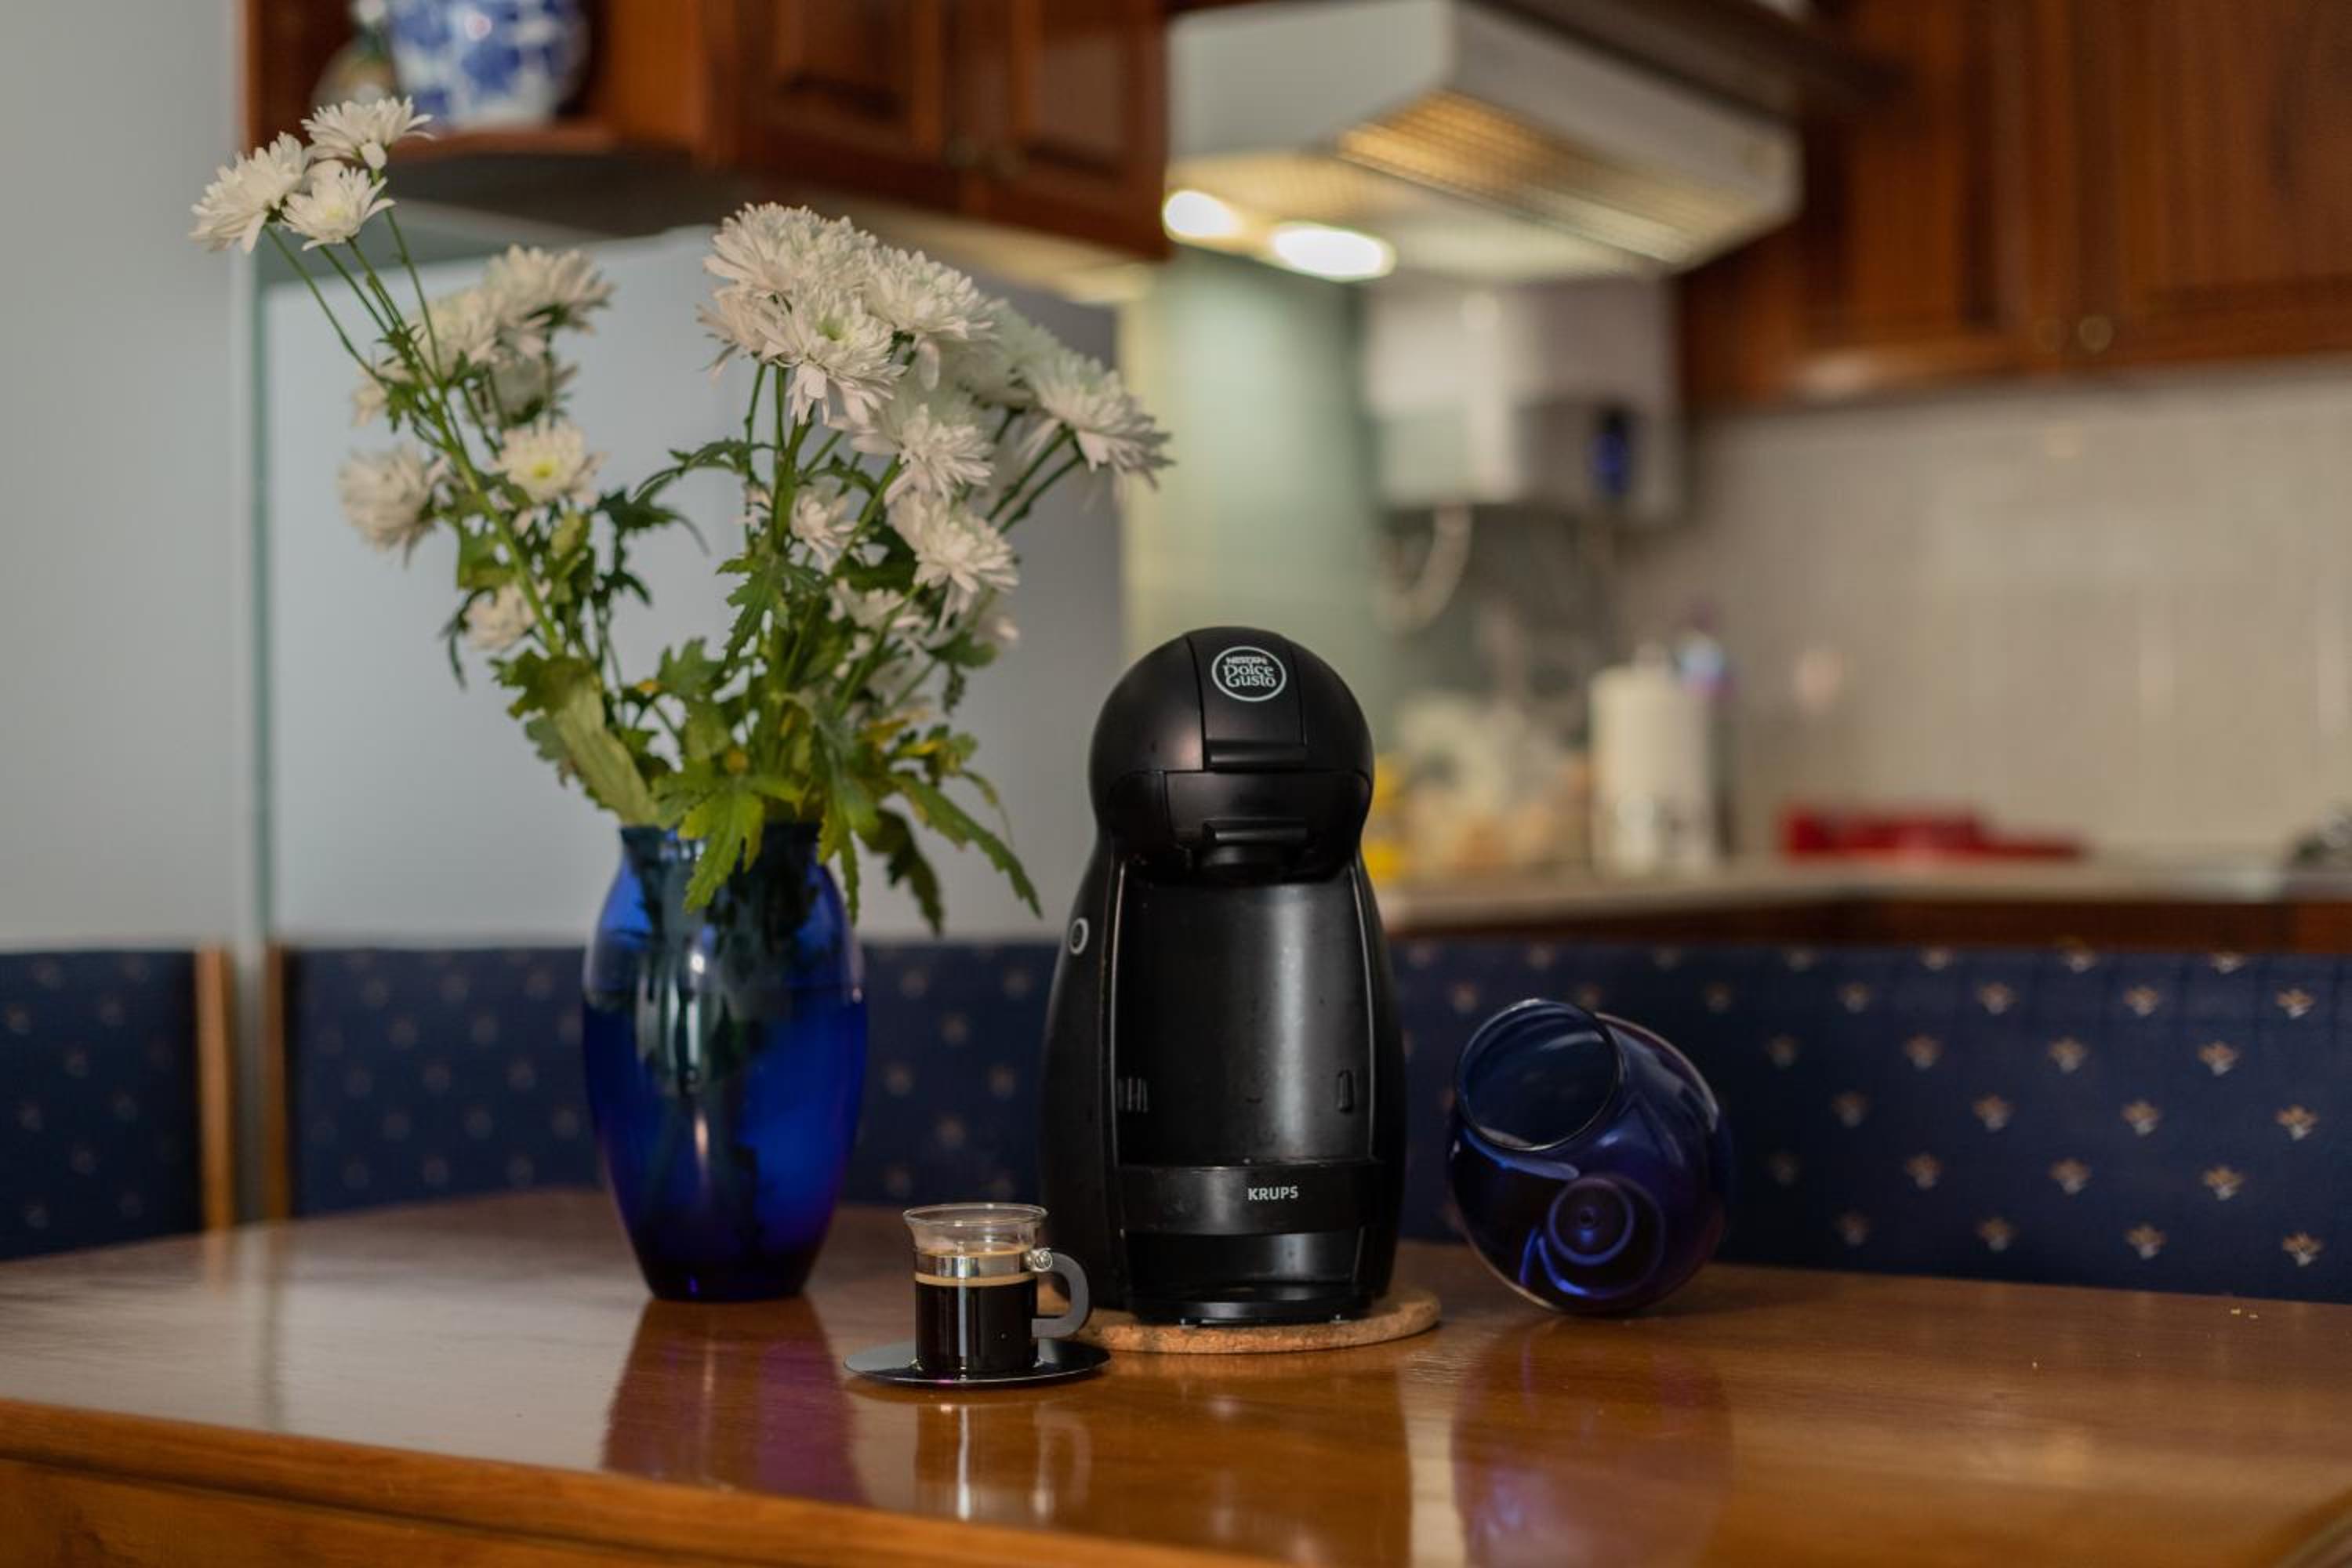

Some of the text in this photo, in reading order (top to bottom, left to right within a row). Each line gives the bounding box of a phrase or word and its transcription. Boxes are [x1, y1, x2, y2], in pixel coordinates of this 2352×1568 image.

[1223, 664, 1273, 676] Dolce
[1225, 675, 1276, 687] Gusto
[1248, 1185, 1298, 1200] KRUPS
